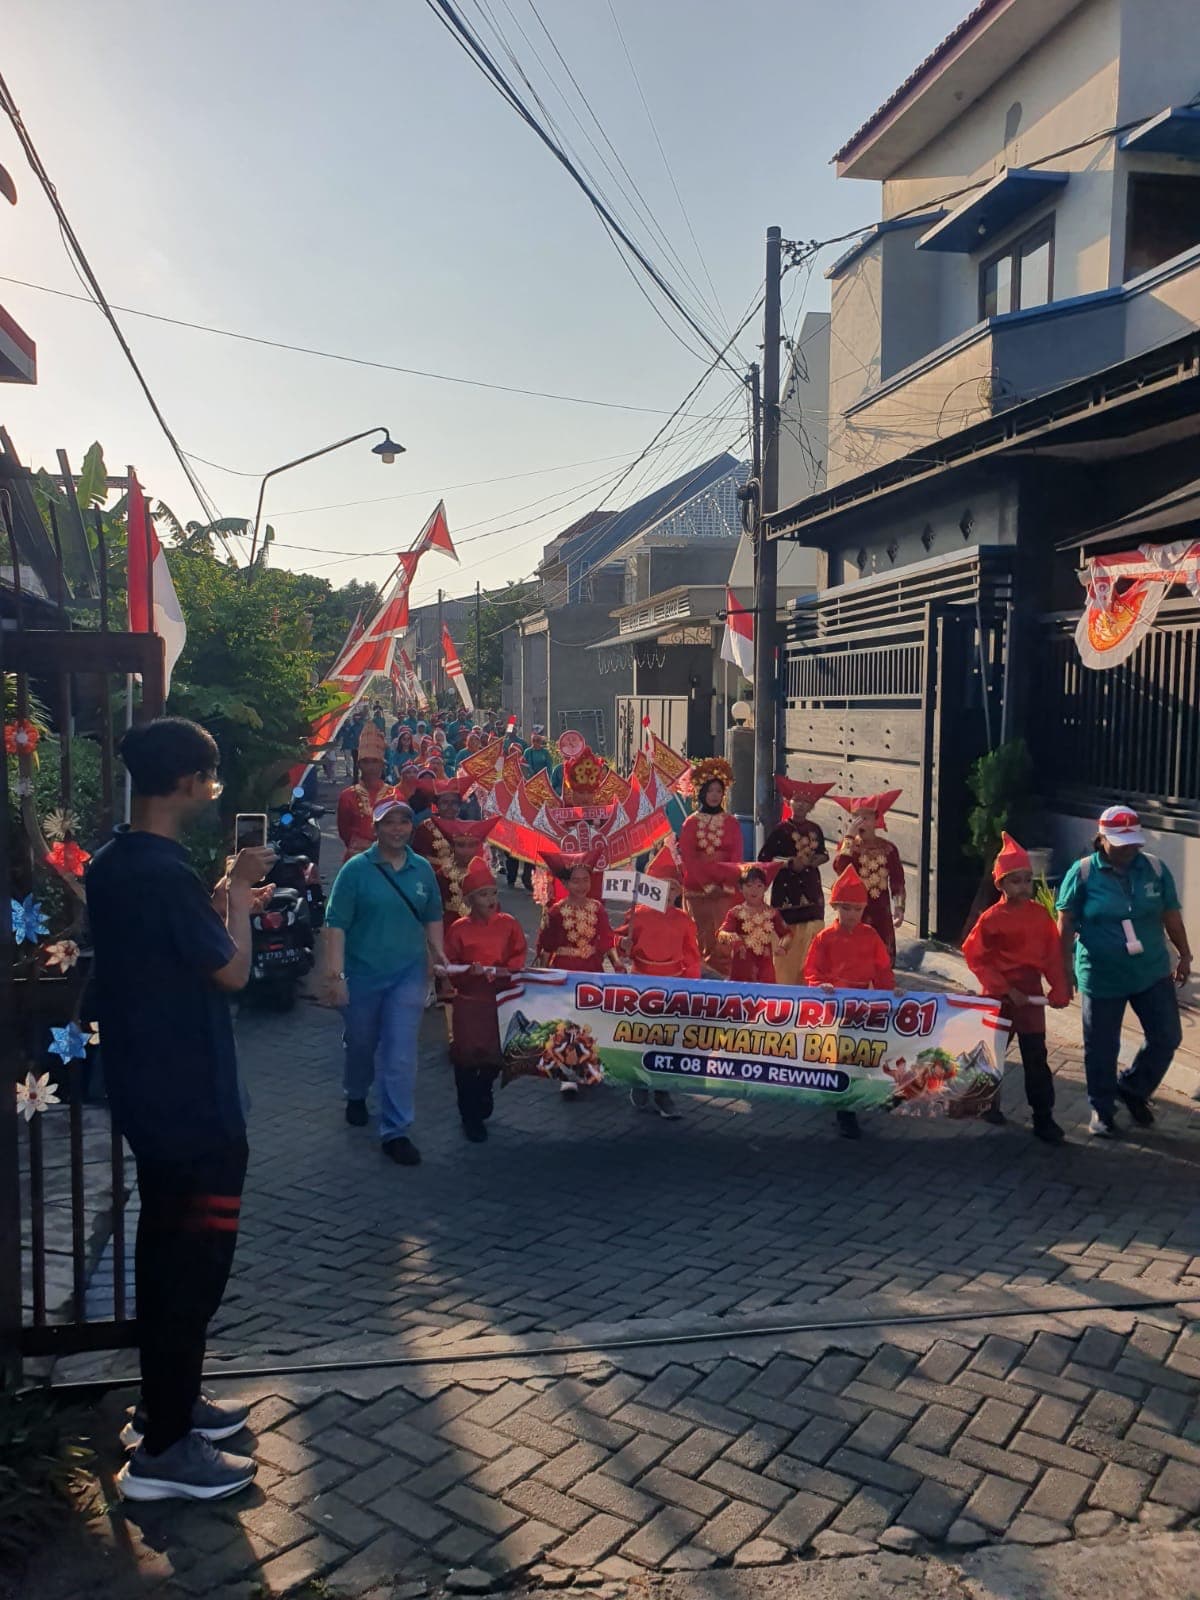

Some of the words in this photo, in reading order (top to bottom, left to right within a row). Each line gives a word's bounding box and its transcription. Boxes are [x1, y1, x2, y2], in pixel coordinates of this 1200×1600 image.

[637, 882, 662, 901] 08
[576, 982, 794, 1027] DIRGAHAYU
[795, 996, 838, 1028] RI
[840, 997, 892, 1032] KE
[894, 997, 938, 1036] 81
[613, 1020, 679, 1046] ADAT
[682, 1024, 798, 1059] SUMATRA
[804, 1033, 888, 1068] BARAT
[654, 1055, 675, 1070] RT.
[680, 1057, 701, 1073] 08
[706, 1059, 735, 1076] RW.
[741, 1063, 763, 1080] 09
[768, 1066, 839, 1089] REWWIN
